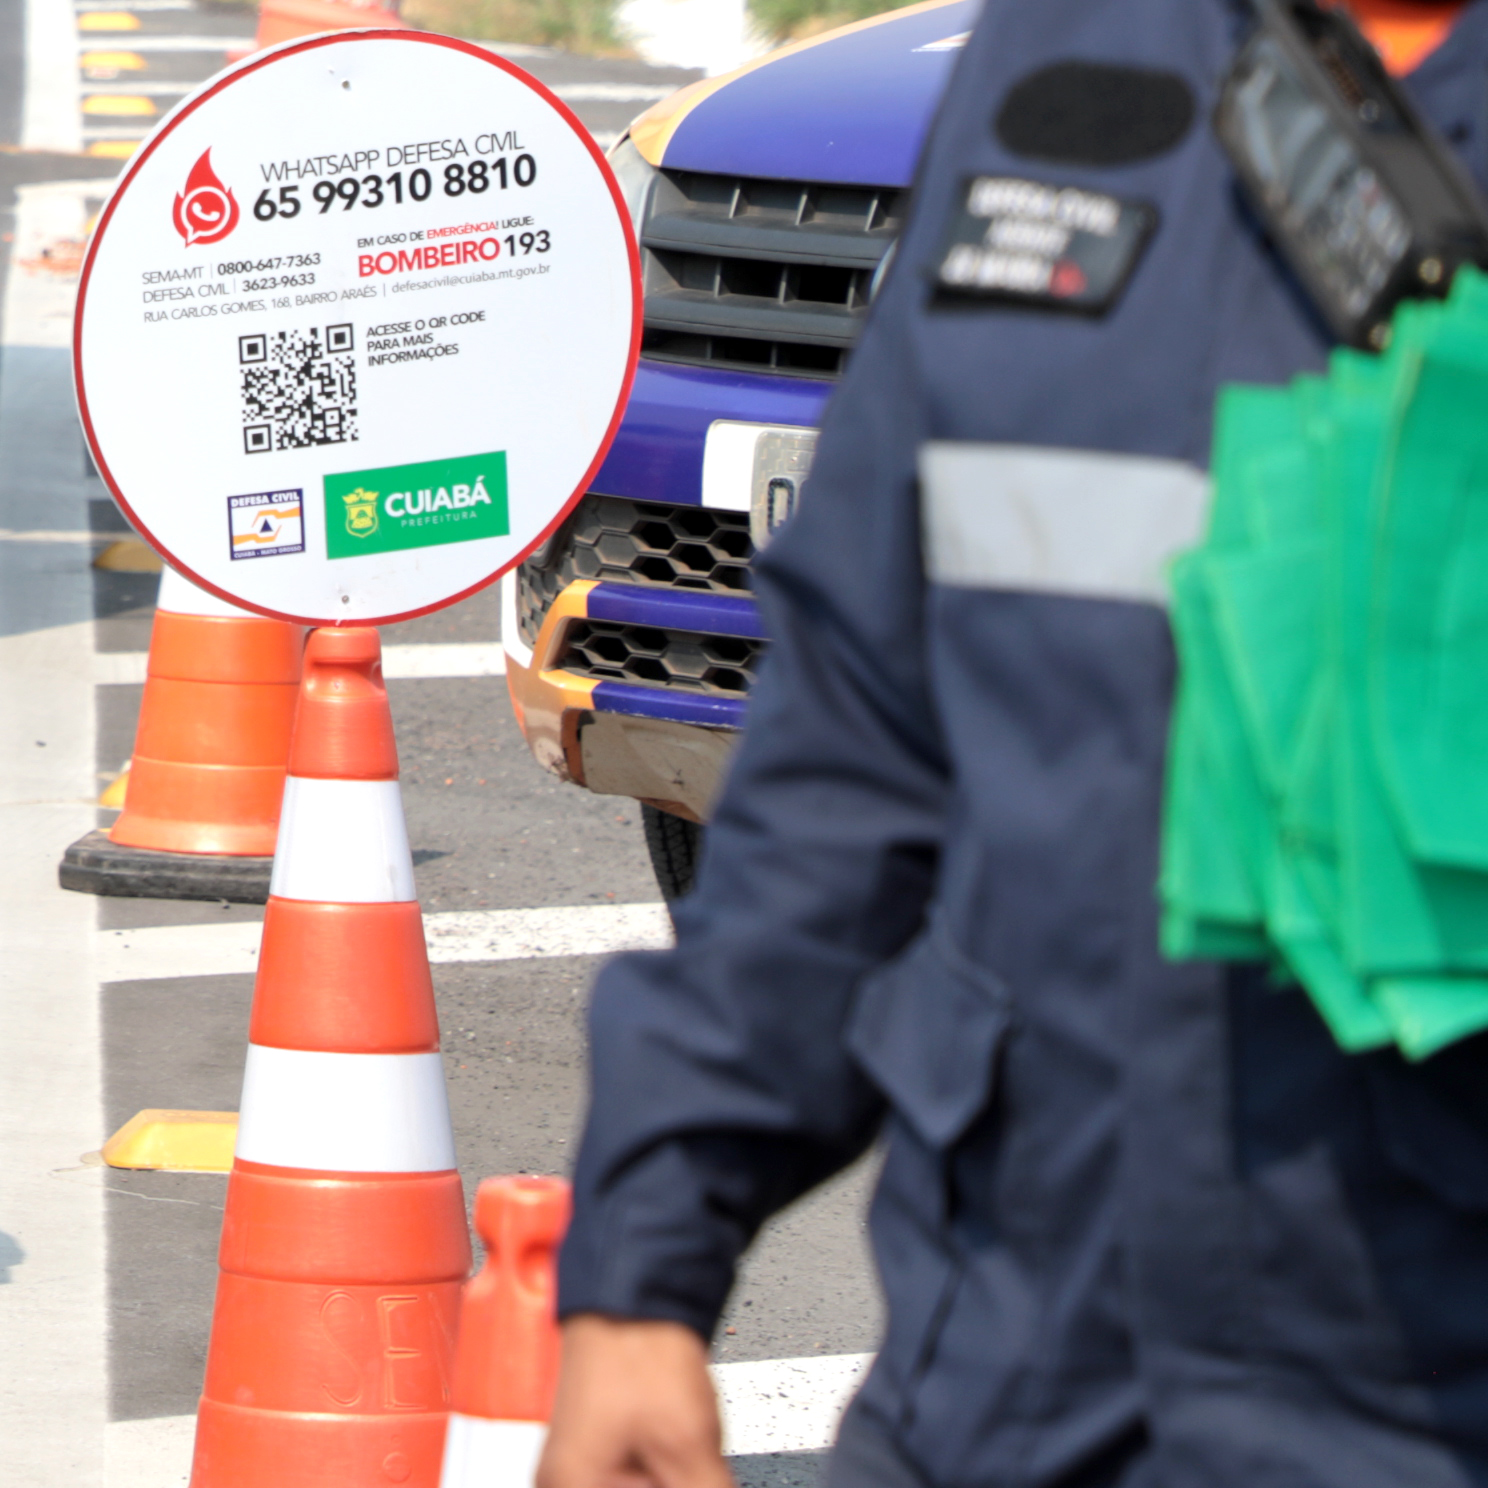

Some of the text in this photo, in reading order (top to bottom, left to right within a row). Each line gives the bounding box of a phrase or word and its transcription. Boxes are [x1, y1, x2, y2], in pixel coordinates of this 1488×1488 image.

[260, 130, 525, 183] WHATSAPP DEFESA CIVIL
[253, 153, 537, 222] 65 99310 8810
[357, 215, 535, 249] EM CASO DE EMERGÊNCIA! LIGUE:
[142, 252, 322, 285] SEMA-MT 0800-647-7363
[358, 229, 551, 278] BOMBEIRO 193
[143, 272, 316, 304] DEFESA CIVIL 3623-9633
[144, 264, 551, 323] RUA CARLOS GOMES, 168, BAIRRO ARAÉS defesacivil@cuiaba.mt.gov.br
[366, 310, 486, 338] ACESSE O QR CODE
[367, 332, 434, 352] PARA MAIS
[368, 343, 459, 367] INFORMAÇÕES
[230, 491, 300, 508] DEFESA CIVIL
[384, 474, 492, 518] CUIABÁ
[401, 510, 478, 528] PREFEITURA
